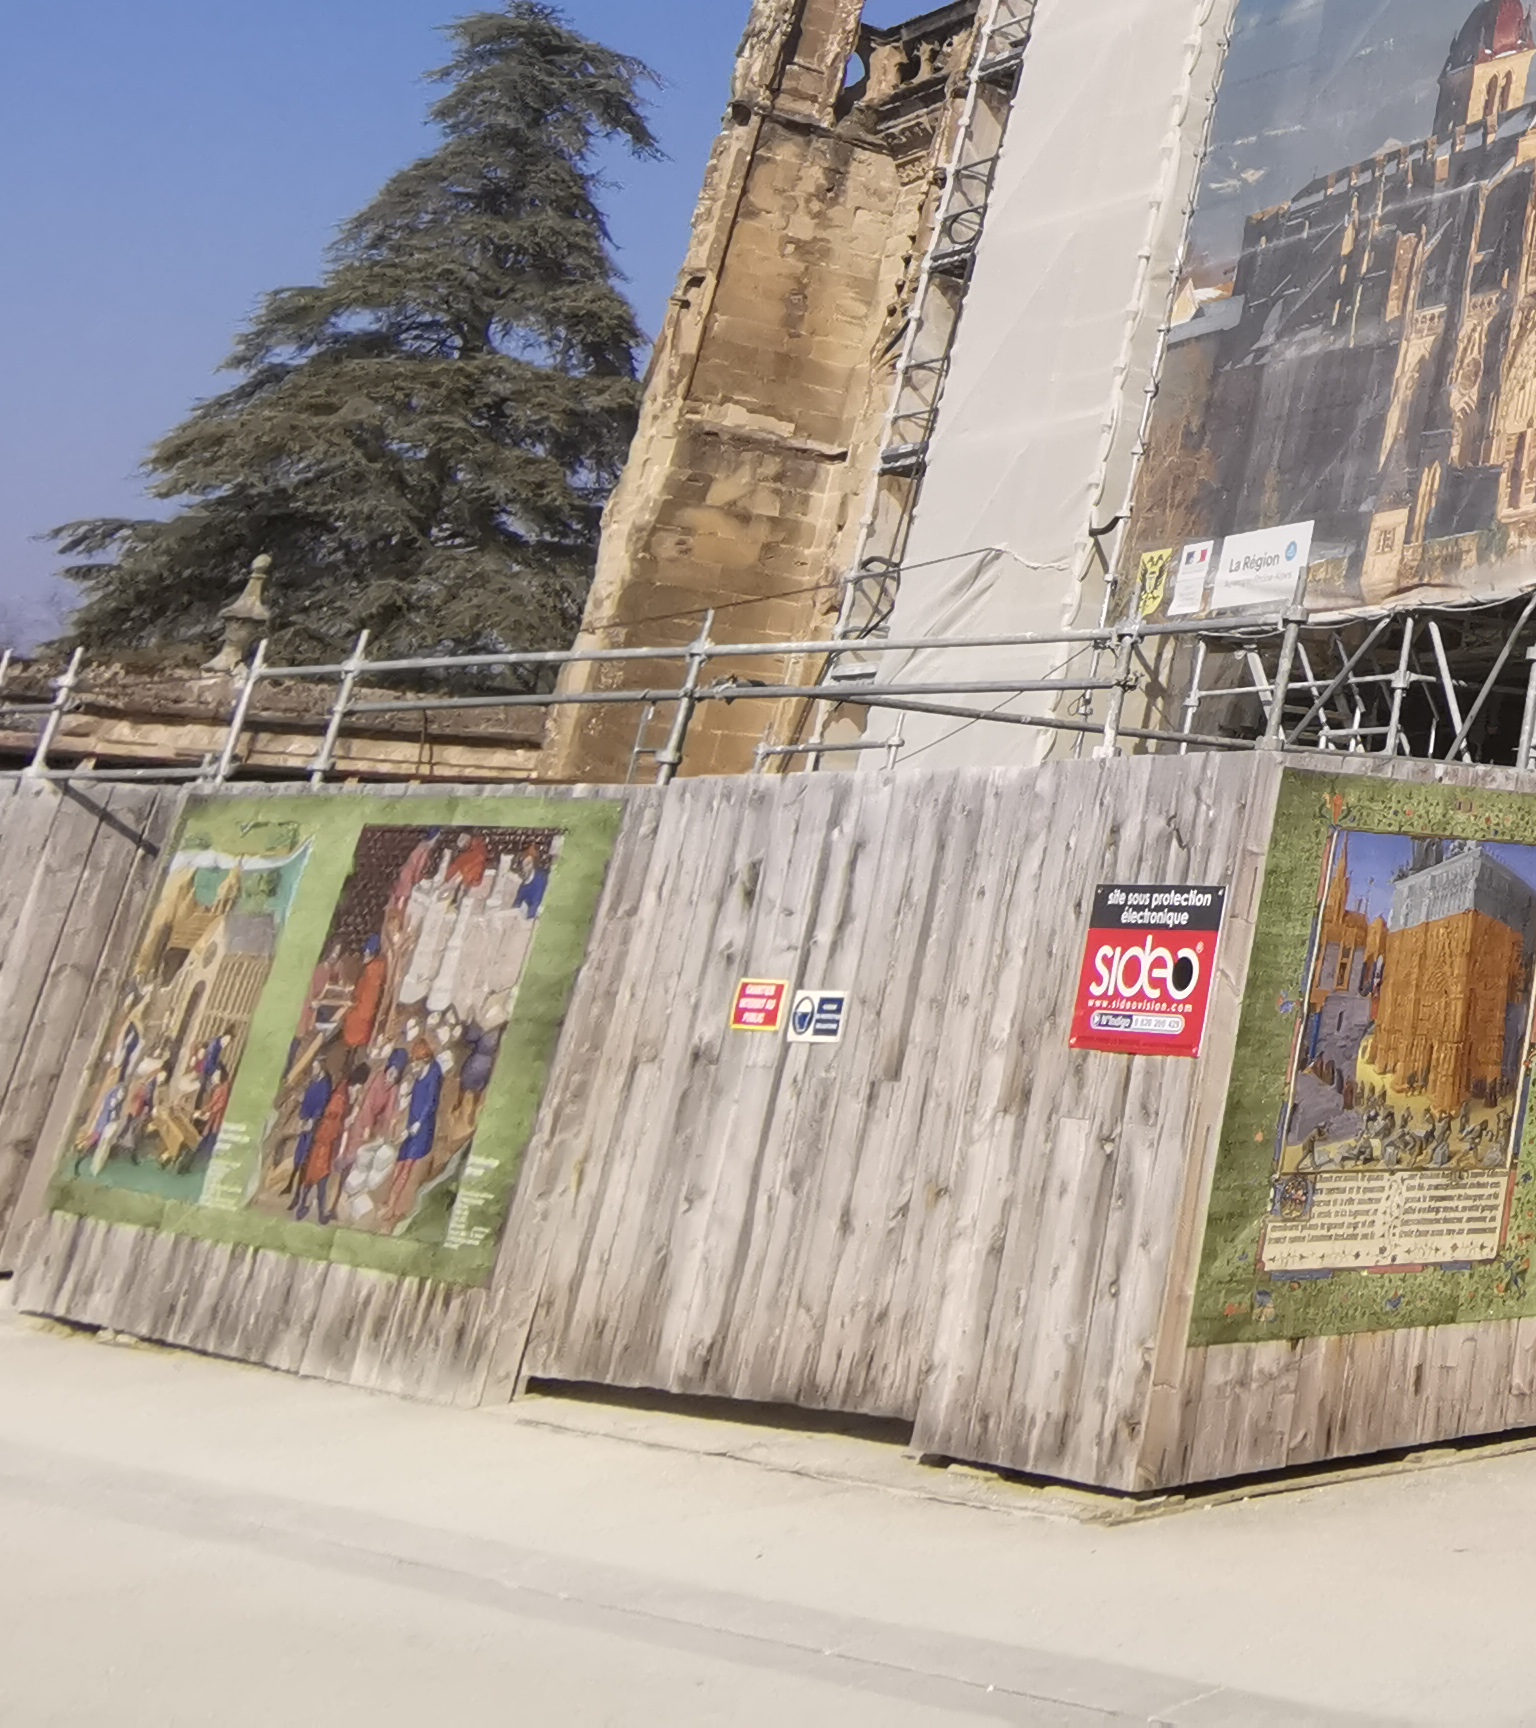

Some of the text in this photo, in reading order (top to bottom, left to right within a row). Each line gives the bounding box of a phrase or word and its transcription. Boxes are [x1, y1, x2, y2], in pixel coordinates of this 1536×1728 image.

[1229, 552, 1280, 573] La Région
[1108, 889, 1211, 909] site sous protection
[1121, 907, 1189, 928] électronique
[1088, 997, 1192, 1013] www.sideovision.com
